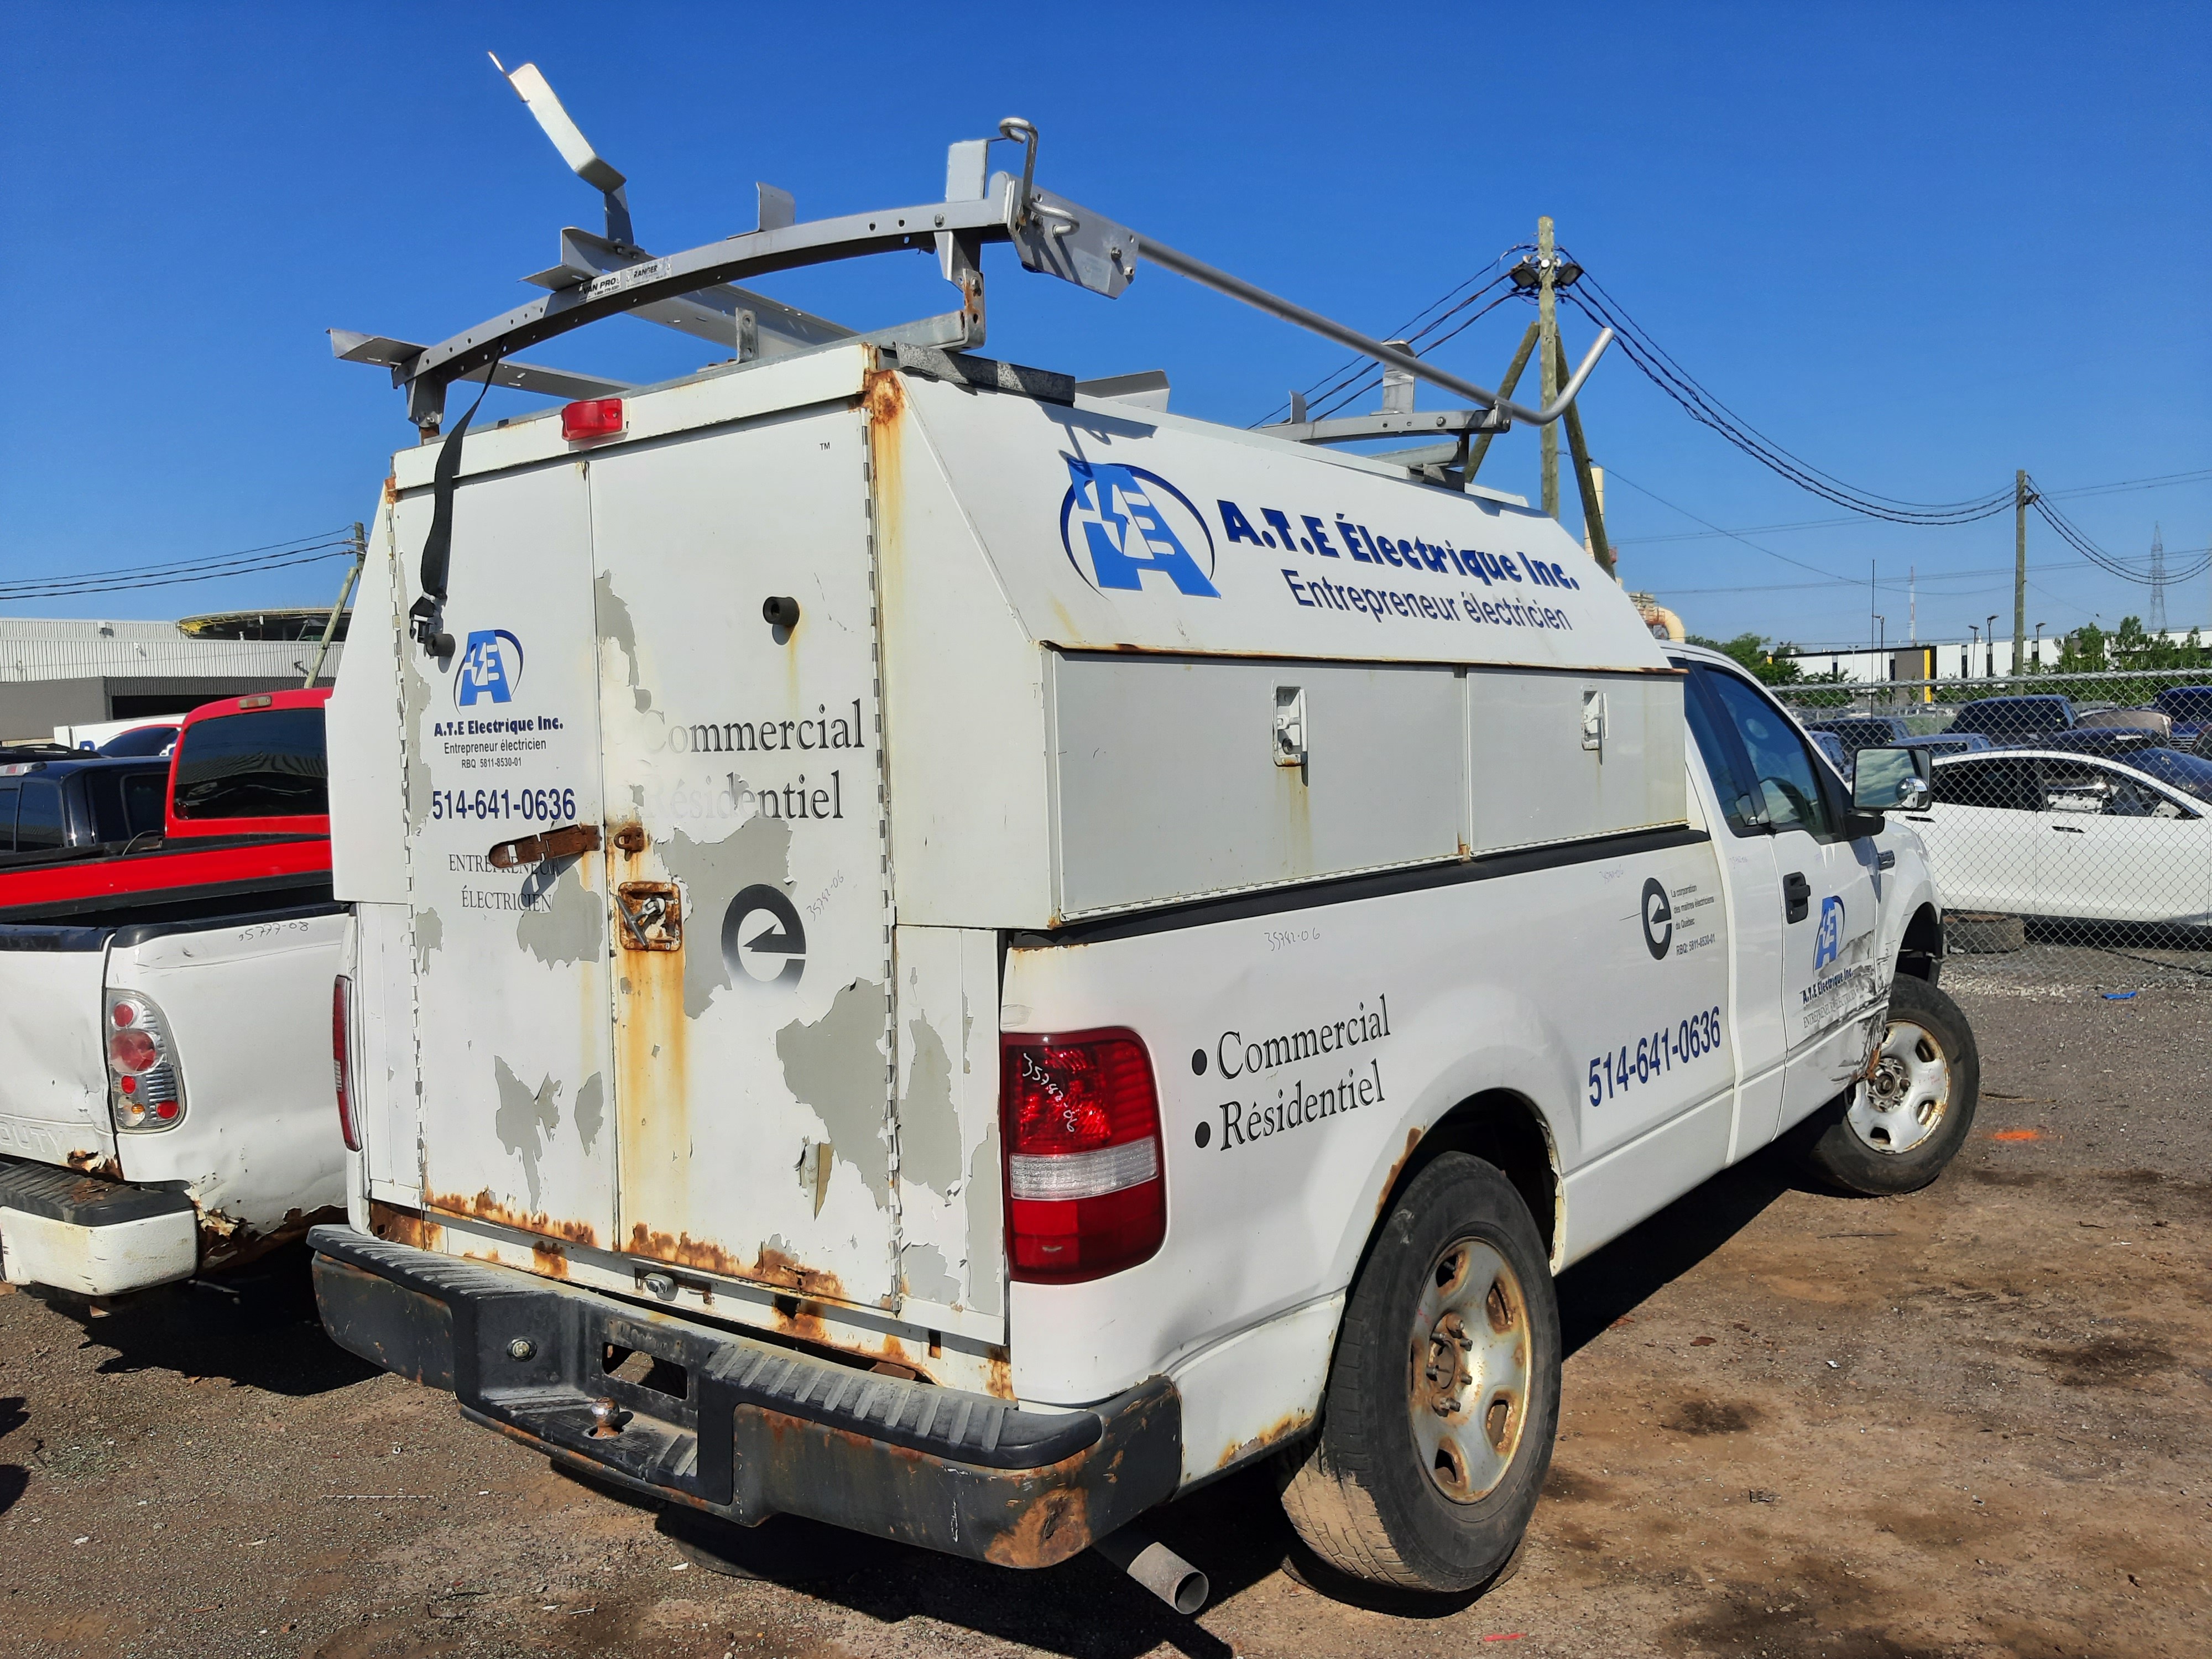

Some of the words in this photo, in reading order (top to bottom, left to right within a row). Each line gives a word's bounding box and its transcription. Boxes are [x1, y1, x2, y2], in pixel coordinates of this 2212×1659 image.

[600, 278, 616, 289] PRO
[634, 265, 658, 278] RANGER
[820, 442, 830, 451] TM
[1217, 499, 1340, 559] A.T.E
[1334, 513, 1522, 586] Électrique
[1516, 551, 1580, 590] Inc.
[1280, 569, 1461, 624] Entrepreneur
[1460, 591, 1573, 630] électricien
[434, 721, 465, 737] A.T.E
[468, 718, 534, 735] Electrique
[538, 716, 564, 731] Inc.
[444, 742, 498, 756] Entrepreneur
[500, 738, 546, 752] électricien
[461, 759, 476, 769] RBQ
[480, 757, 522, 768] 5811-8530-01
[432, 788, 577, 821] 514-641-0636
[448, 854, 561, 876] ENTREENEUR
[461, 885, 552, 911] ÉLECTRICIEN
[1217, 993, 1391, 1079] Commercial
[1589, 1006, 1720, 1107] 514-641-0636
[1219, 1058, 1385, 1151] Résidentiel
